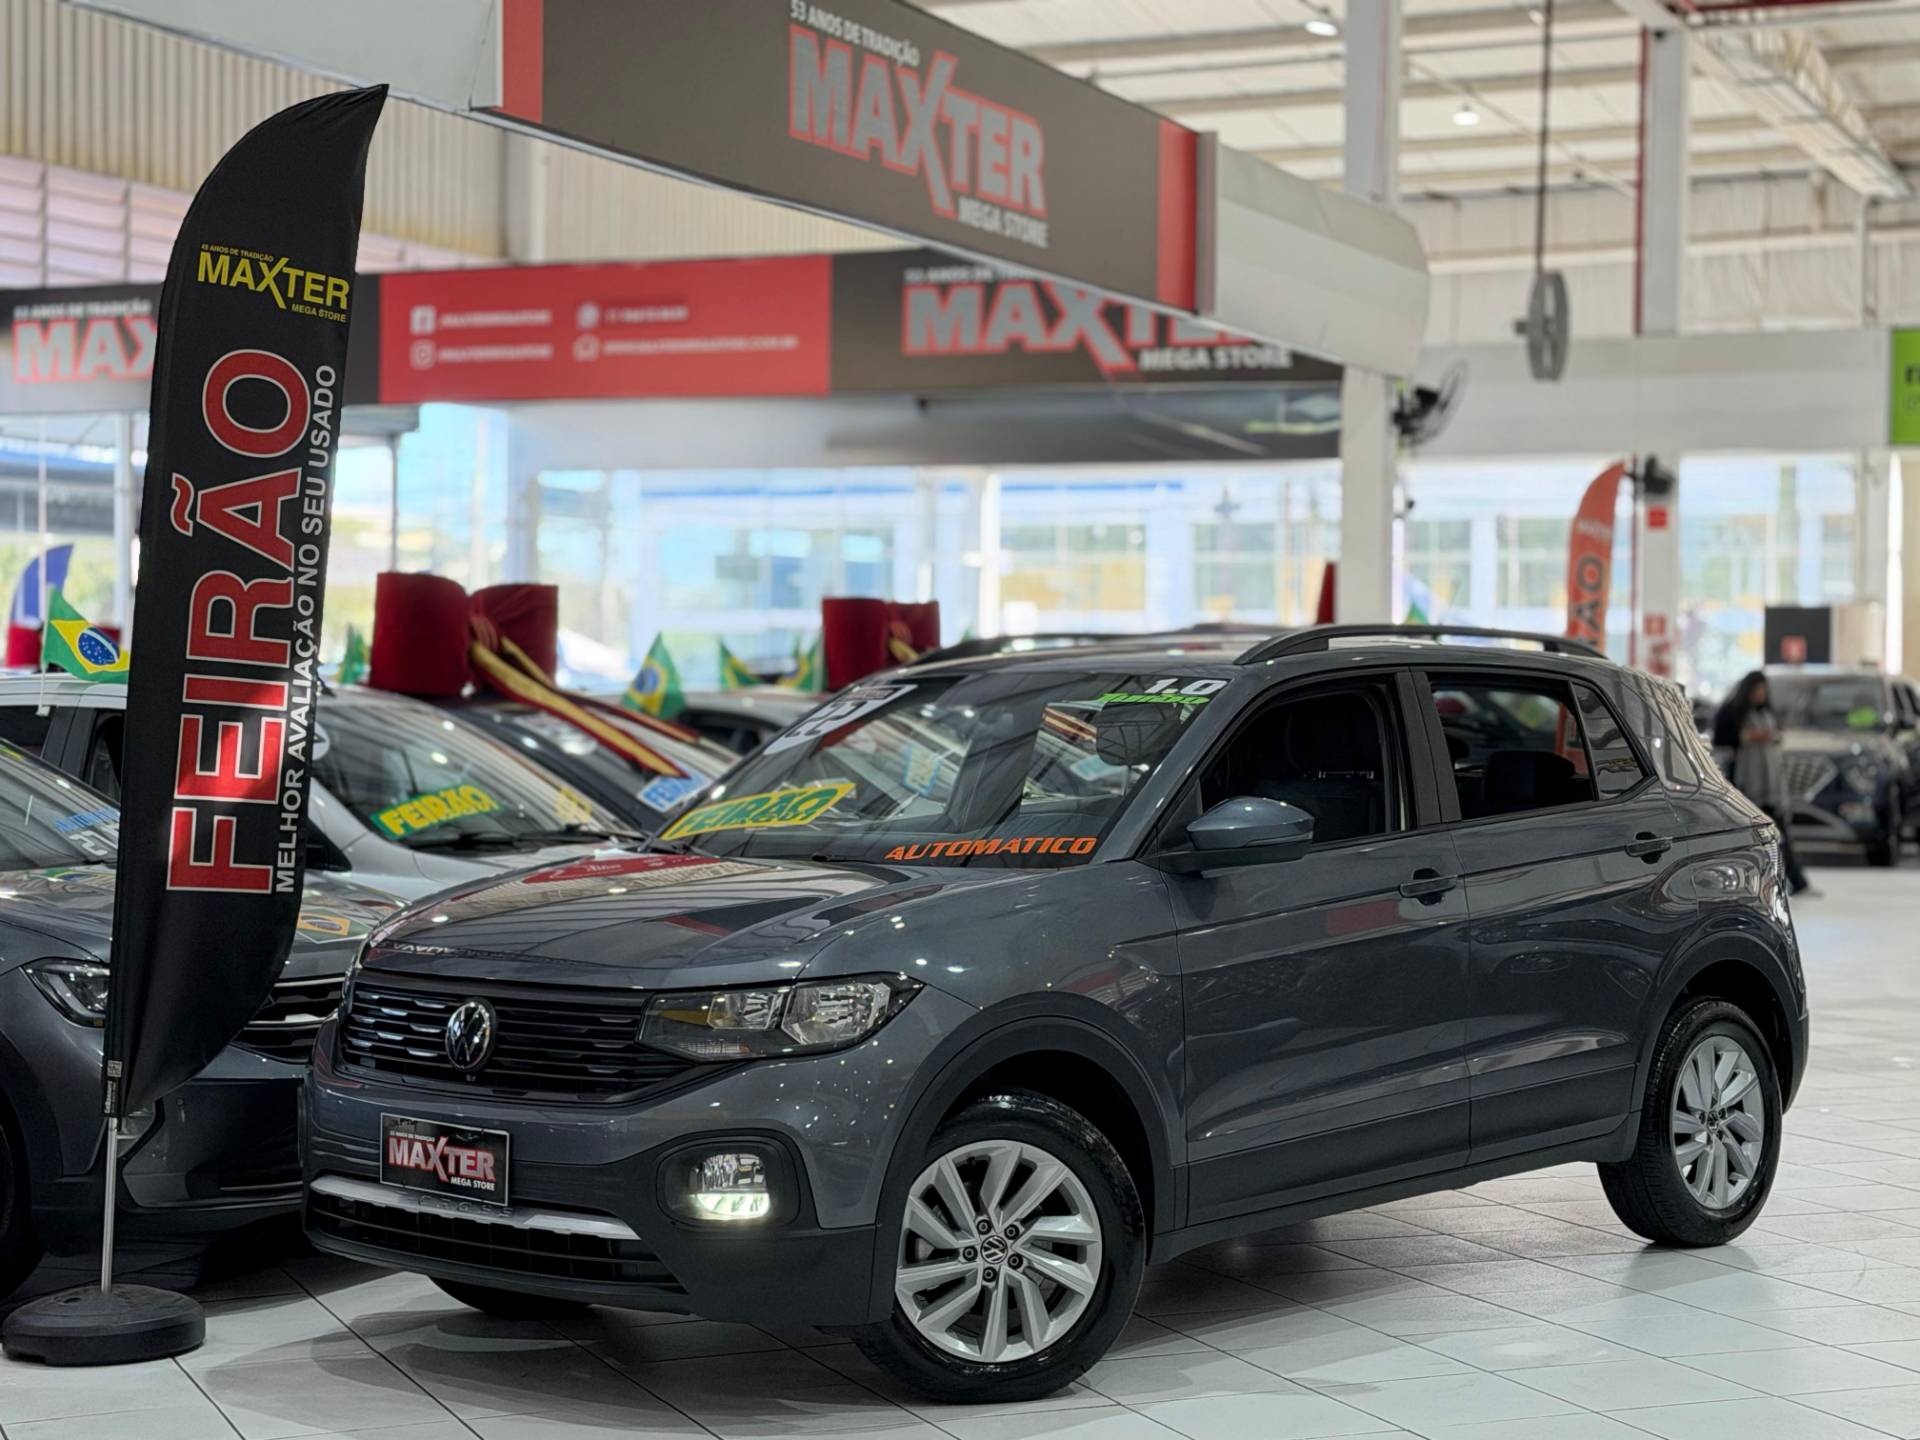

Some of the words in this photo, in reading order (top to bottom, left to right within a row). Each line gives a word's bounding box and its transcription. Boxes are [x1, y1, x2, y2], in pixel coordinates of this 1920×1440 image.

[807, 5, 843, 37] ANOS
[843, 20, 861, 45] DE
[788, 22, 1048, 219] MAXTER
[957, 196, 1002, 235] MEGA
[1002, 210, 1050, 250] STORE
[197, 251, 350, 310] MAXTER
[291, 303, 317, 317] MEGA
[318, 308, 347, 323] STORE
[1139, 347, 1210, 371] MEGA
[1213, 346, 1293, 369] STORE
[308, 364, 337, 469] USADO
[301, 476, 327, 536] SEU
[296, 543, 320, 587] NO
[166, 349, 311, 894] FEIRÃO
[287, 595, 318, 762] AVALIAÇÃO
[1143, 678, 1228, 695] 1.0
[275, 768, 305, 893] MELHOR
[884, 837, 1098, 861] AUTOMATICO
[387, 1136, 496, 1183] MAXTER
[450, 1176, 472, 1188] MEGA
[473, 1180, 496, 1192] STORE
